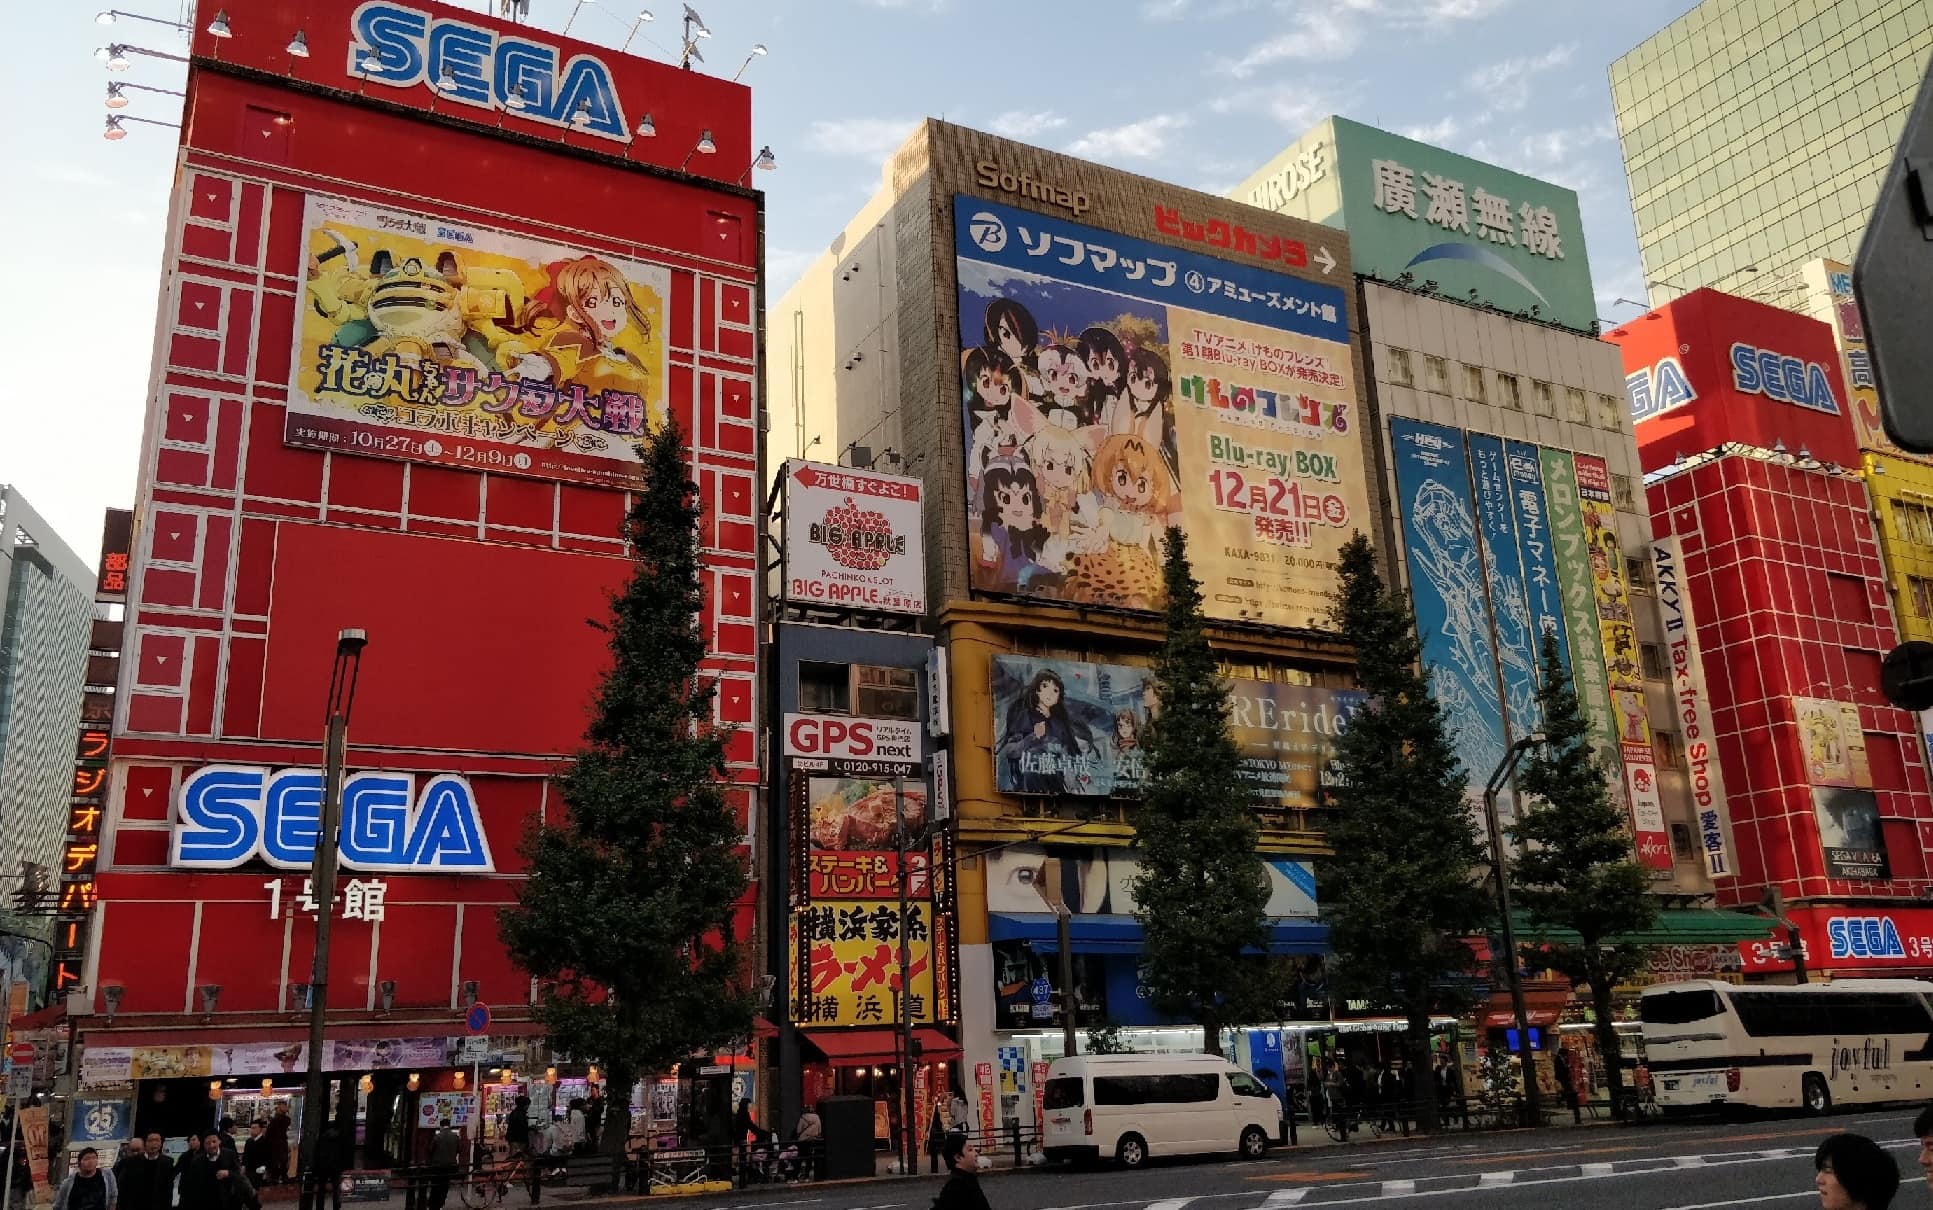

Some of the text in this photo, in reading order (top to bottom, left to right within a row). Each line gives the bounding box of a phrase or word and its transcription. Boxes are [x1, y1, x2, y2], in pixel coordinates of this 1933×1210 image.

[349, 1, 632, 143] SEGA
[976, 160, 1091, 216] Sofmap
[1017, 226, 1177, 288] ソフマップ
[1153, 204, 1309, 270] ビックカメラ
[1730, 342, 1841, 417] SEGA
[1209, 434, 1337, 479] Blu-ray BOX
[809, 522, 906, 555] BIG APPLE
[792, 578, 825, 598] BIG
[1653, 546, 1681, 614] AKKY
[1670, 634, 1700, 740] Tax-free
[1689, 742, 1712, 807] Shop
[789, 718, 874, 756] GPS
[876, 744, 912, 758] next
[843, 761, 912, 775] 0120-915-047
[170, 763, 496, 873] SEGA
[1826, 915, 1907, 959] SEGA
[810, 942, 929, 994] ラーメン
[1829, 1037, 1890, 1081] joyful
